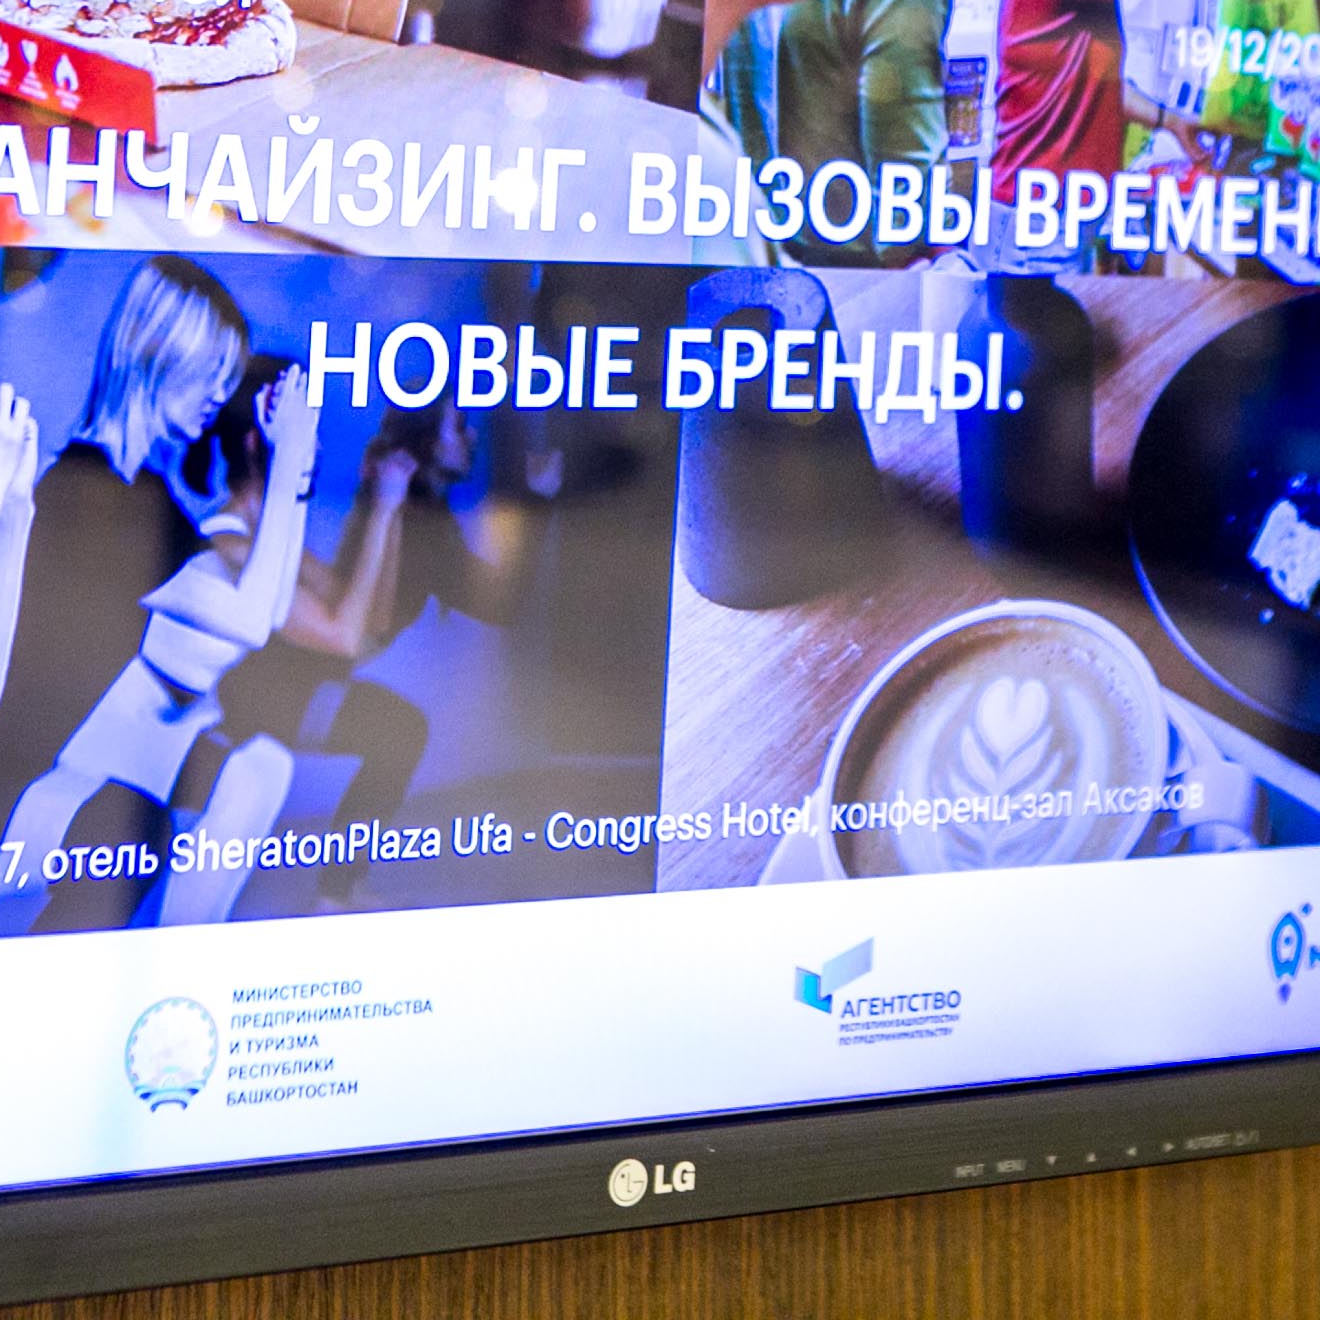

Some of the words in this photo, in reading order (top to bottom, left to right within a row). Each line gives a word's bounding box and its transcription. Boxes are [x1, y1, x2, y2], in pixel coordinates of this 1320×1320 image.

[627, 150, 992, 247] ВЫЗОВЫ
[307, 320, 640, 411] НОВЫЕ
[664, 328, 1025, 424] БРЕНДЫ.
[0, 841, 29, 890] 7,
[41, 842, 160, 882] отель
[170, 817, 442, 874] SheratonPlaza
[453, 813, 514, 856] Ufa
[545, 808, 712, 855] Congress
[721, 794, 820, 839] Hotel,
[830, 787, 1072, 836] конференц-зал
[1081, 780, 1206, 815] Аксаков
[232, 979, 363, 1004] МИНИСТЕРСТВО
[840, 989, 962, 1019] АГЕНТСТВО
[230, 999, 434, 1030] ПРЕДПРИНИМАТЕЛЬСТВА
[228, 1039, 241, 1055] И
[246, 1034, 320, 1054] ТУРИЗМА
[227, 1058, 335, 1081] РЕСПУБЛИКИ
[226, 1080, 359, 1107] БАШКОРТОСТАН
[653, 1160, 697, 1195] LG
